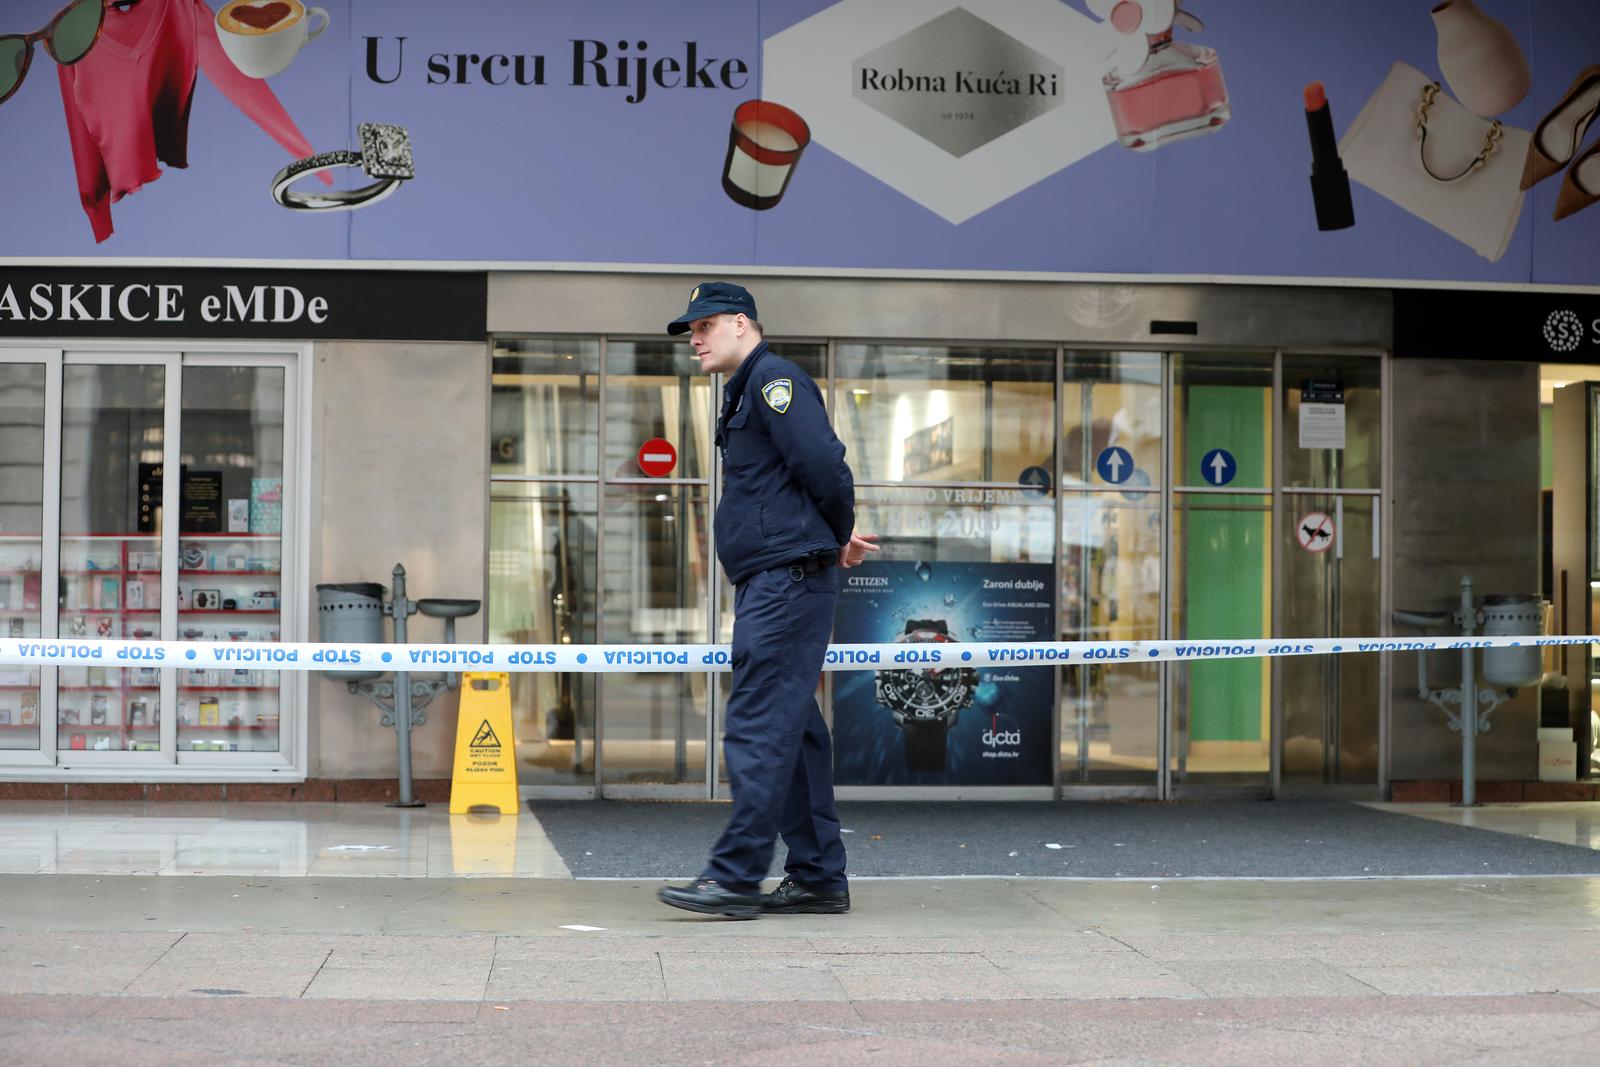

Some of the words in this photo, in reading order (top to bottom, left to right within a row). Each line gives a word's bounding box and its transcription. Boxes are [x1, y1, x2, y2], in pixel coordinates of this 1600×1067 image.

[362, 36, 408, 84] U
[427, 53, 548, 86] srcu
[568, 39, 749, 104] Rijeke
[861, 68, 946, 93] Robna
[955, 70, 1021, 95] Kuća
[1028, 73, 1057, 96] Ri
[0, 283, 186, 321] ASKICE
[200, 285, 329, 324] eMDe
[848, 576, 888, 586] CITIZEN
[983, 579, 1013, 589] Zaroni
[1014, 580, 1045, 592] dublje
[18, 644, 103, 659] POLICIJA
[116, 647, 166, 660] STOP
[213, 648, 299, 663] POLICIJA
[312, 649, 362, 664] STOP
[825, 649, 881, 664] POLIC
[894, 649, 942, 663] STOP
[987, 648, 1071, 661] POLICIJA
[1083, 647, 1130, 659] STOP
[1175, 645, 1257, 657] POLICIJA
[1268, 644, 1314, 654] STOP
[409, 650, 494, 665] POLICIJA
[507, 650, 557, 665] STOP
[603, 650, 689, 665] POLICIJA
[702, 651, 732, 665] OP
